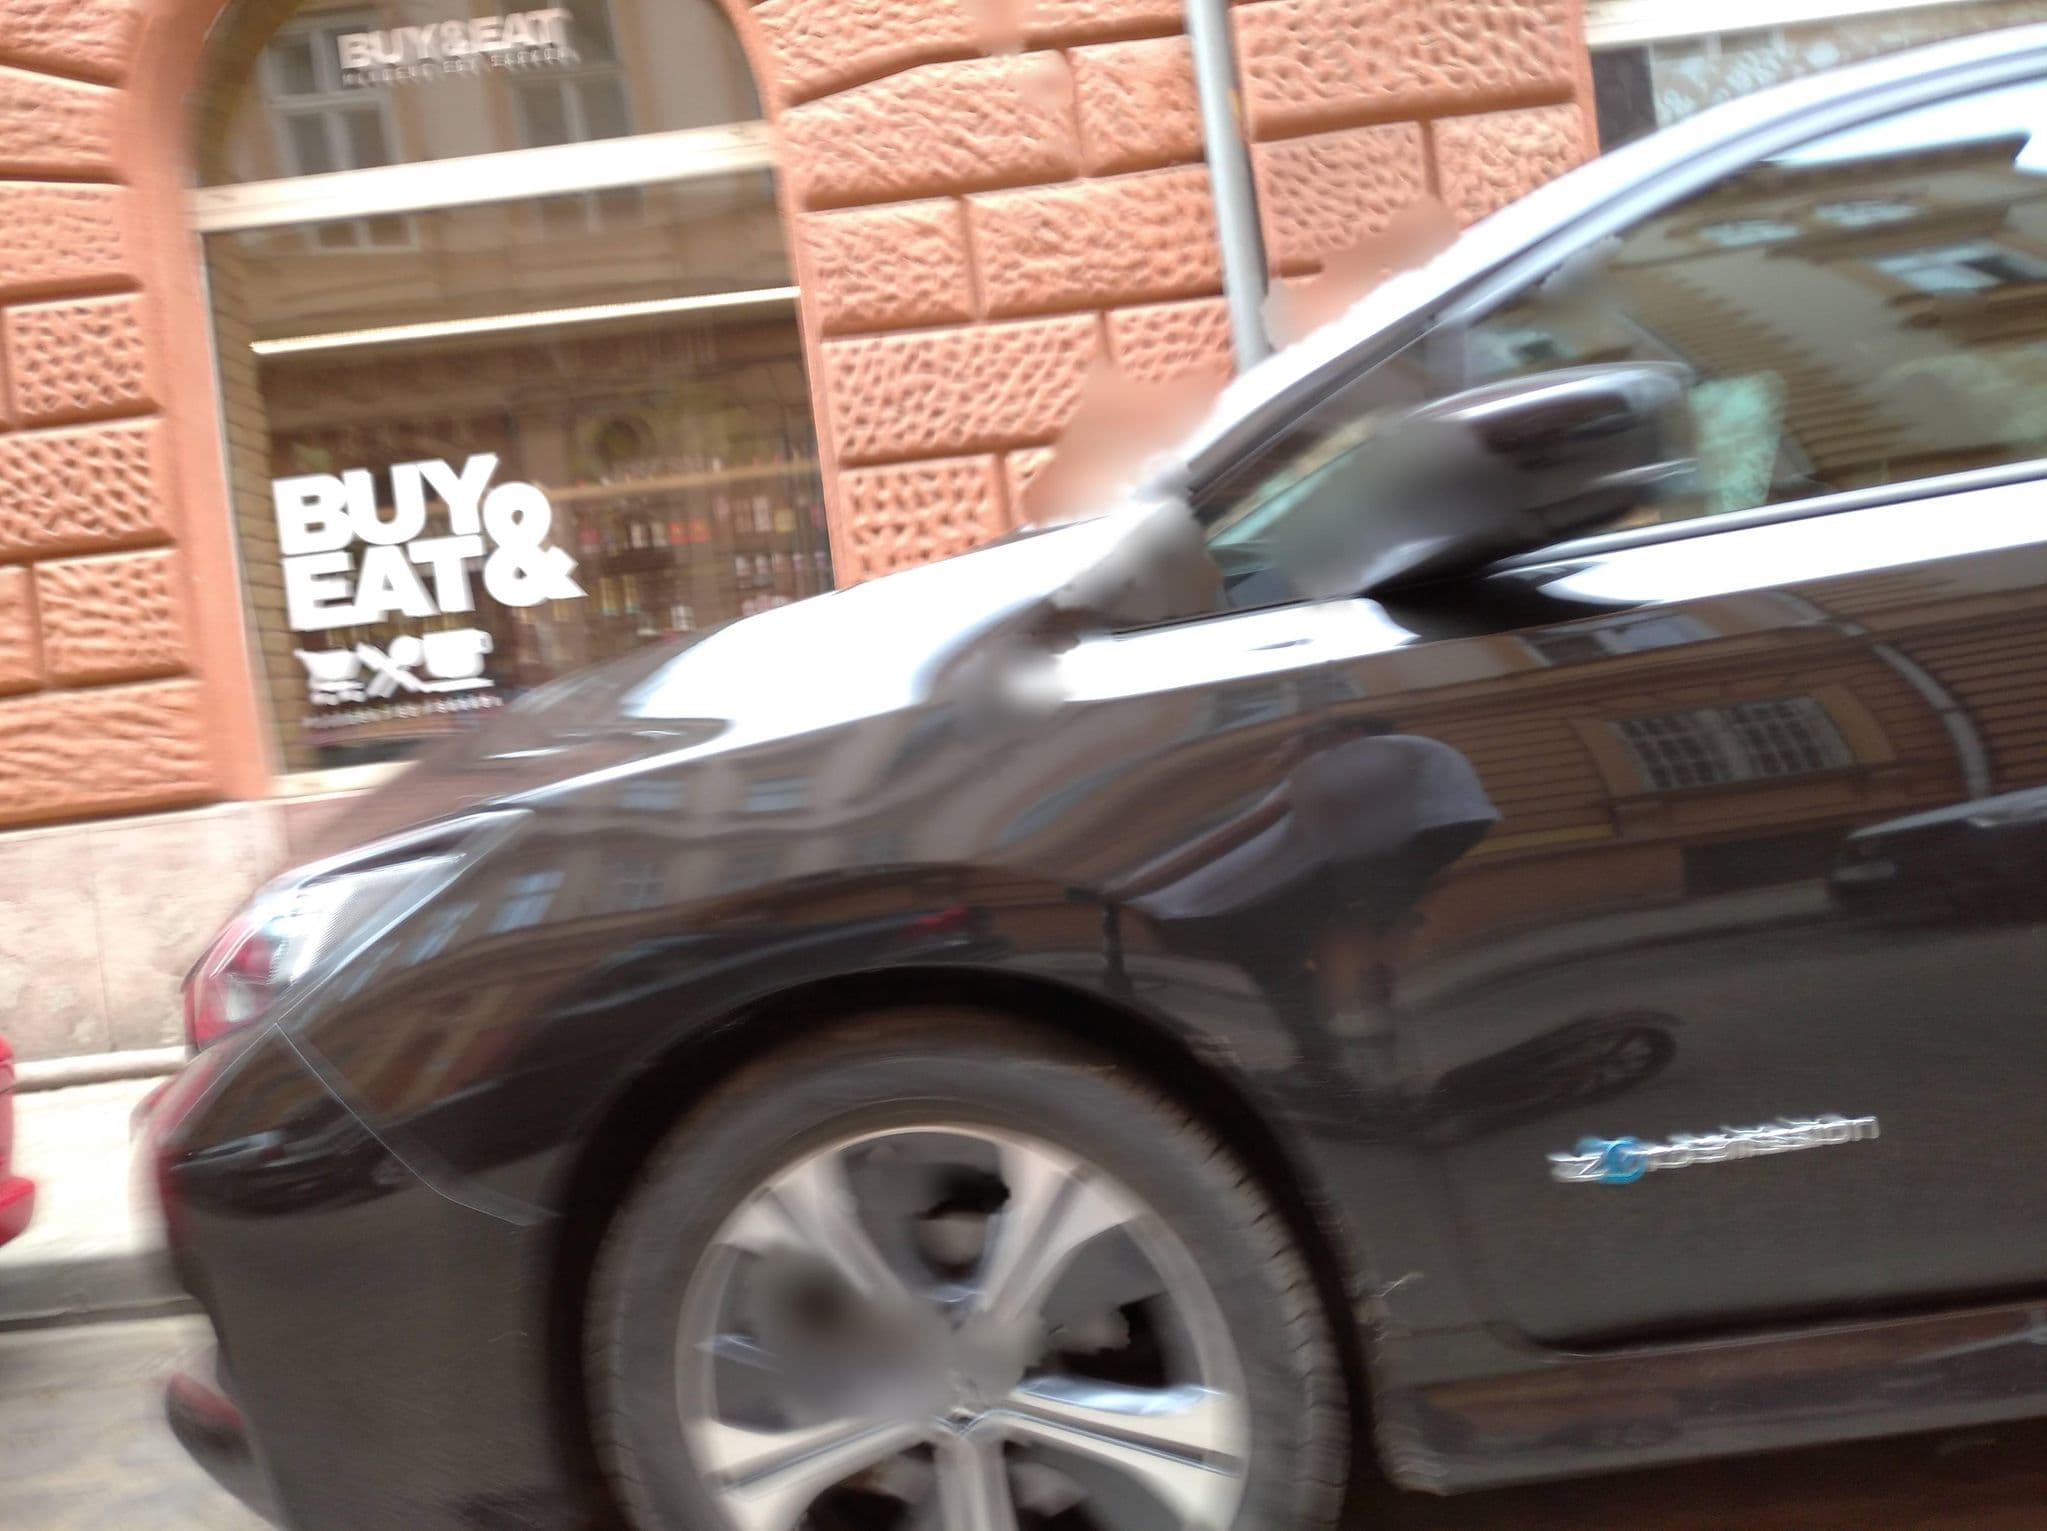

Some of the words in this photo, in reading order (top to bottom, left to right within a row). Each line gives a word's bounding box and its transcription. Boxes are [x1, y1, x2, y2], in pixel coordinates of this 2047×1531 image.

[337, 8, 573, 69] BUY&EAT
[271, 451, 500, 556] BUY
[482, 481, 590, 608] &
[281, 533, 485, 632] EAT
